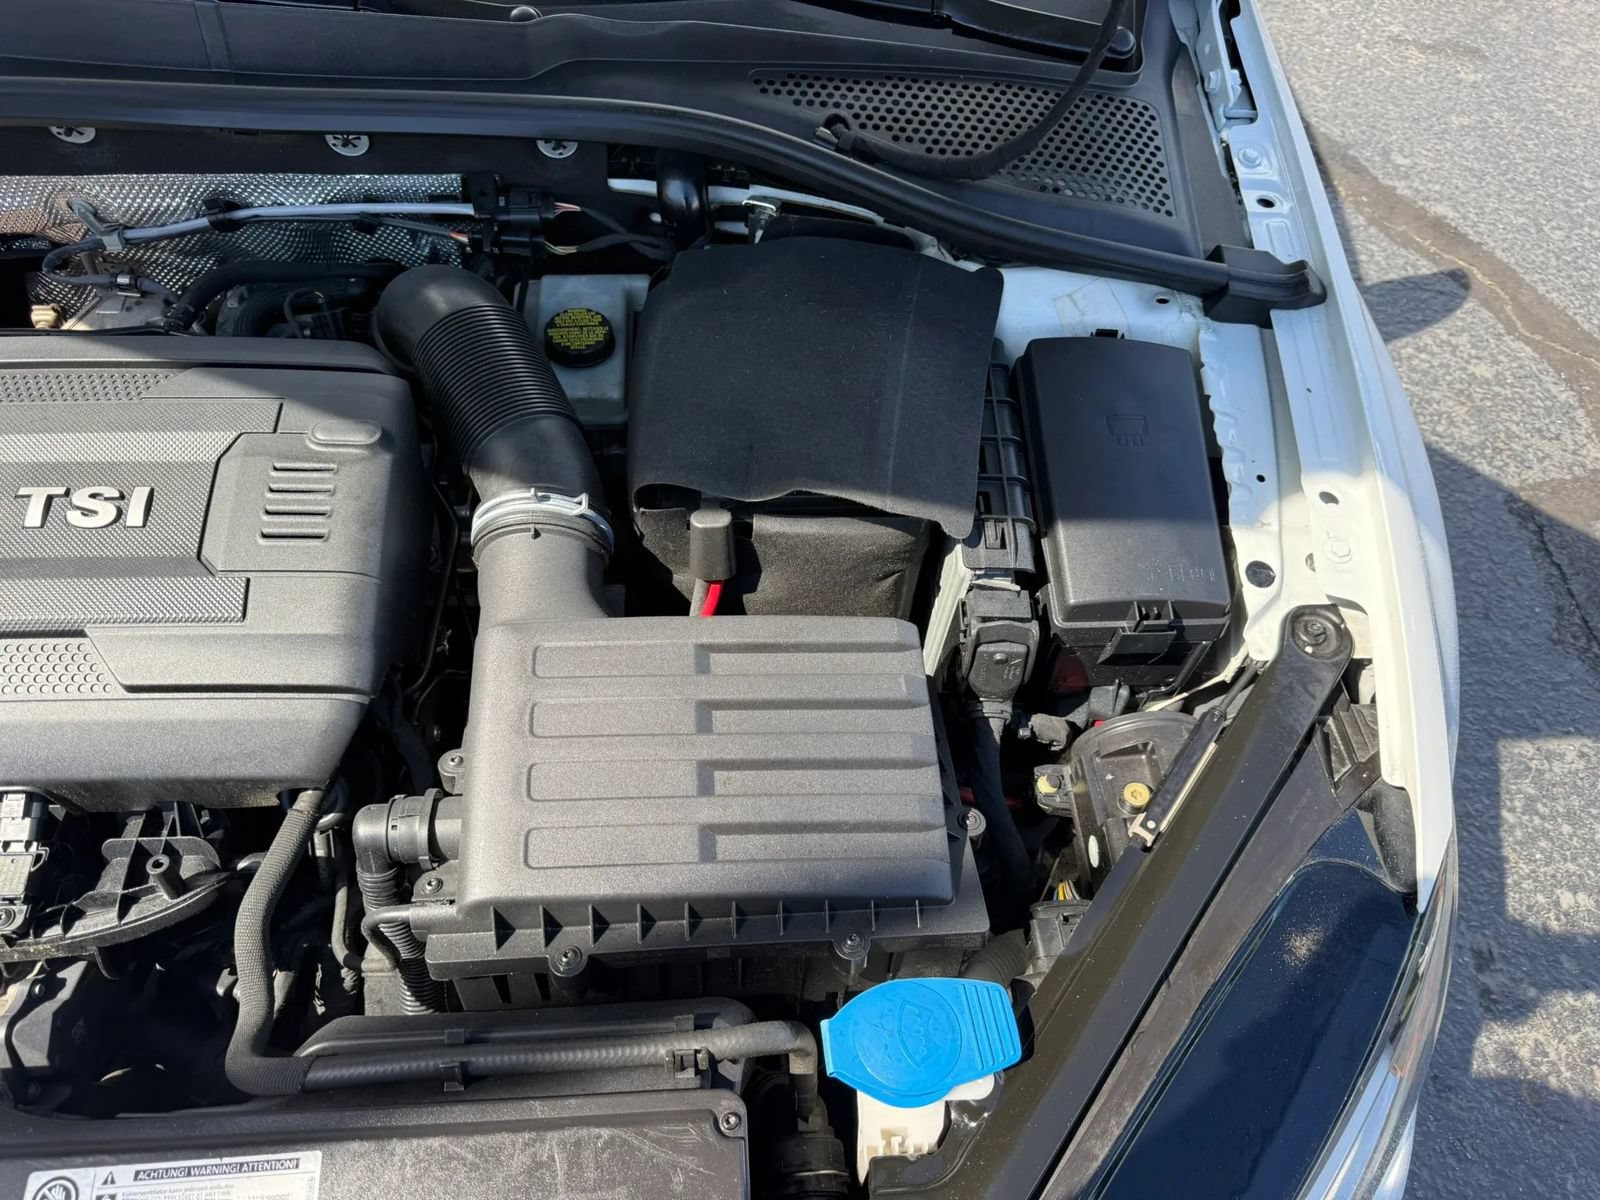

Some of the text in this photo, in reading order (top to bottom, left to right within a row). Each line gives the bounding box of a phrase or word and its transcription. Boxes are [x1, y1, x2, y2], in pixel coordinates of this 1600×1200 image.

[15, 485, 154, 529] TSI
[136, 1159, 298, 1181] ACHTUNG! WARNING! ATTENTION!
